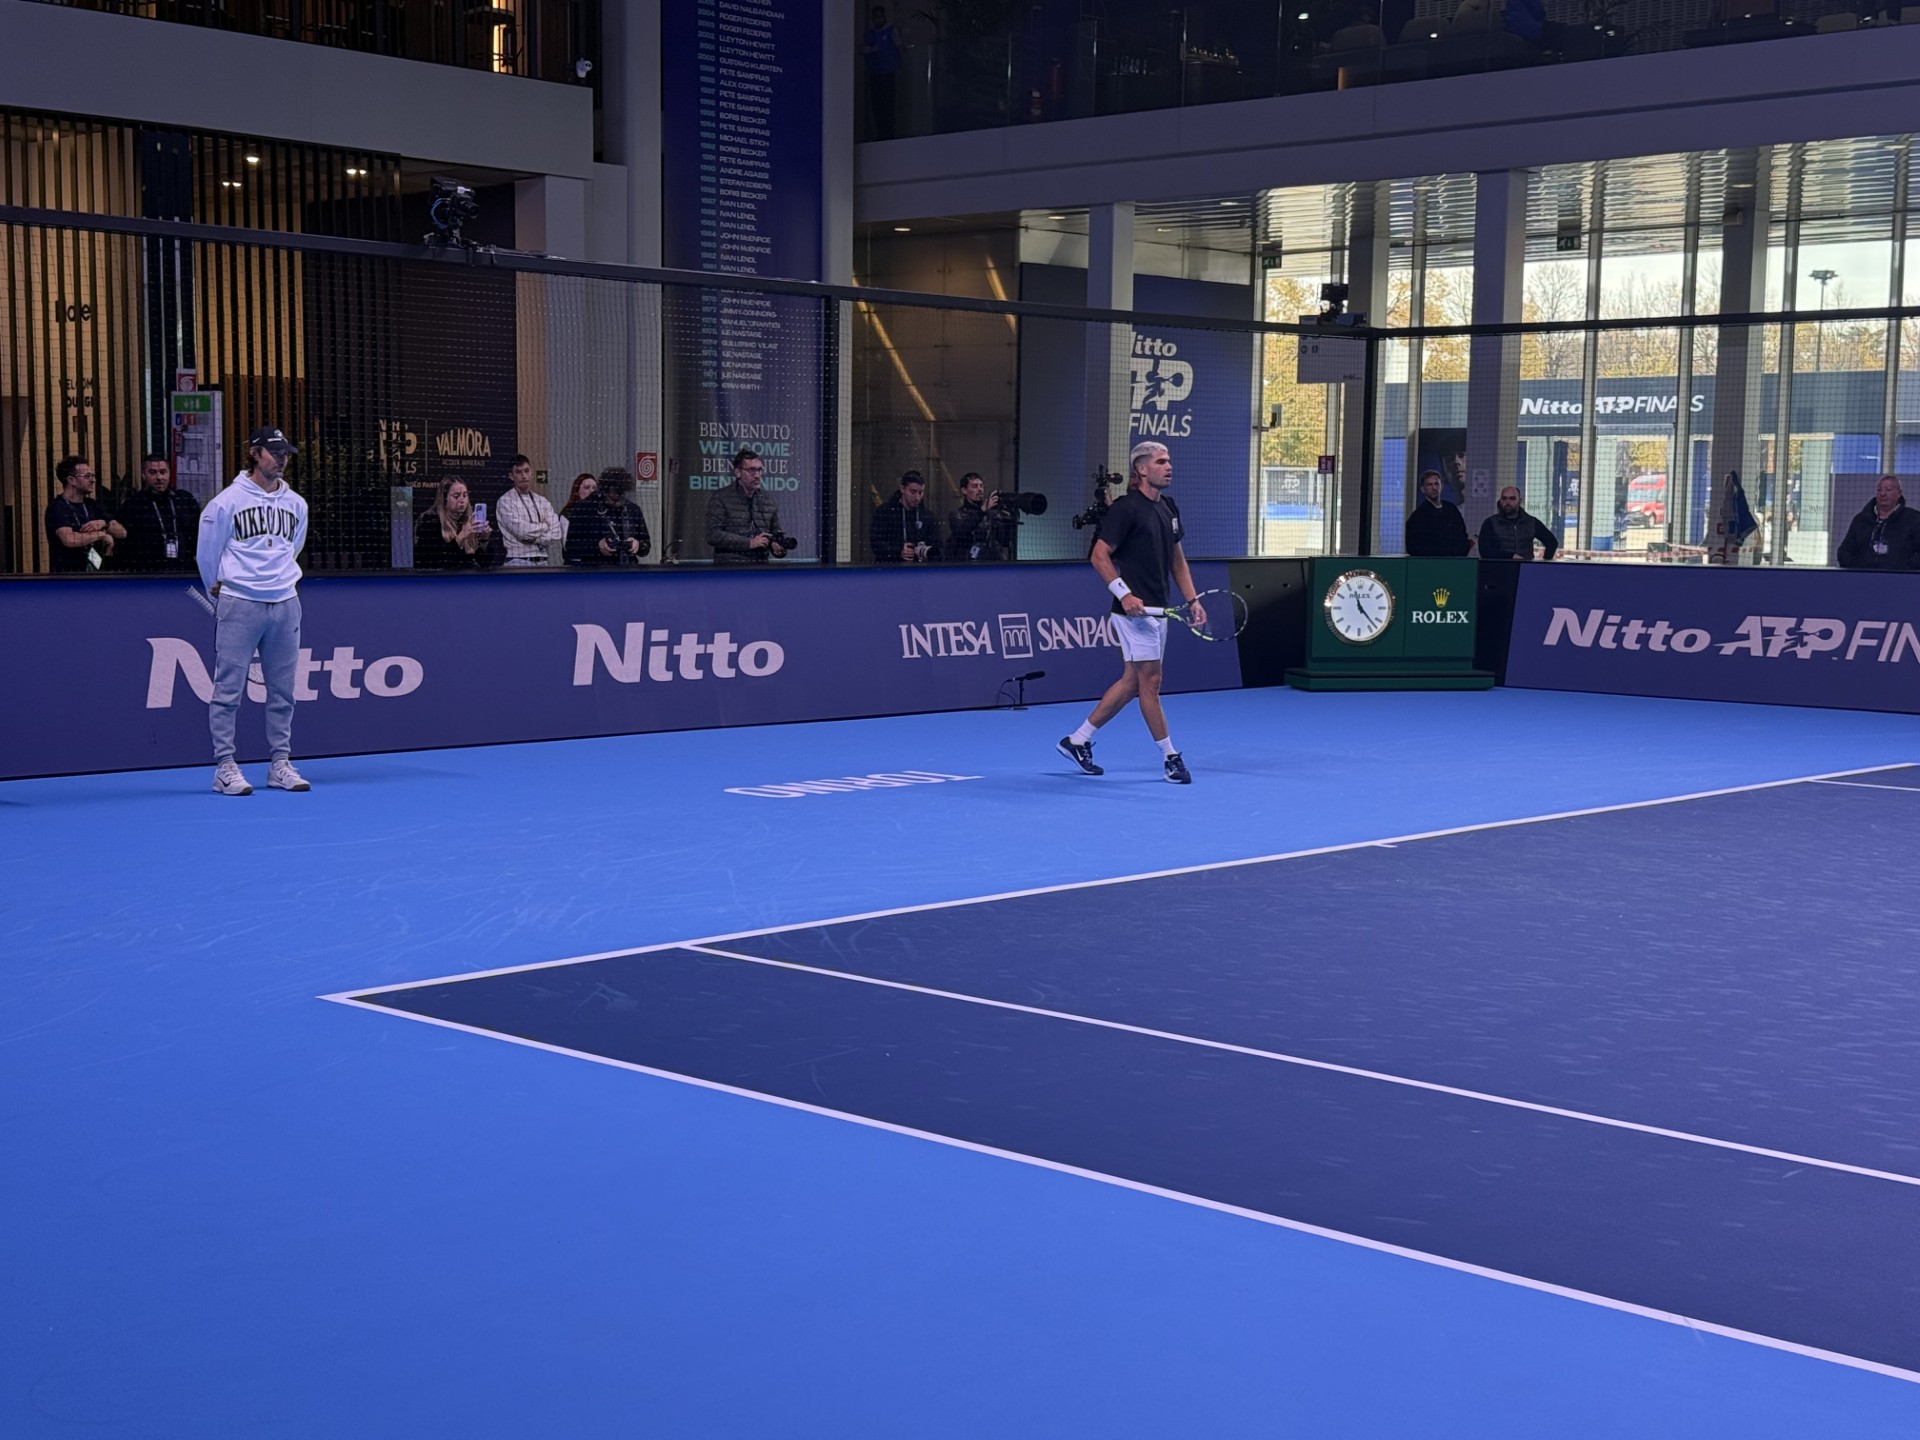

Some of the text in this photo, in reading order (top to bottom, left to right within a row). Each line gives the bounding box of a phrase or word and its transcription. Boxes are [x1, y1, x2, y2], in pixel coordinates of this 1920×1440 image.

[1130, 357, 1193, 411] TP
[1520, 398, 1582, 415] Nitto
[1634, 394, 1705, 413] FINAS
[699, 421, 791, 441] BENVENUTO
[1129, 412, 1192, 437] FINALS
[436, 427, 491, 457] VALMORA
[1411, 610, 1469, 624] ROLEX
[899, 621, 995, 659] INTESA
[1543, 607, 1711, 653] Nitto
[1714, 615, 1846, 659] ATP
[572, 622, 785, 686] Nitto
